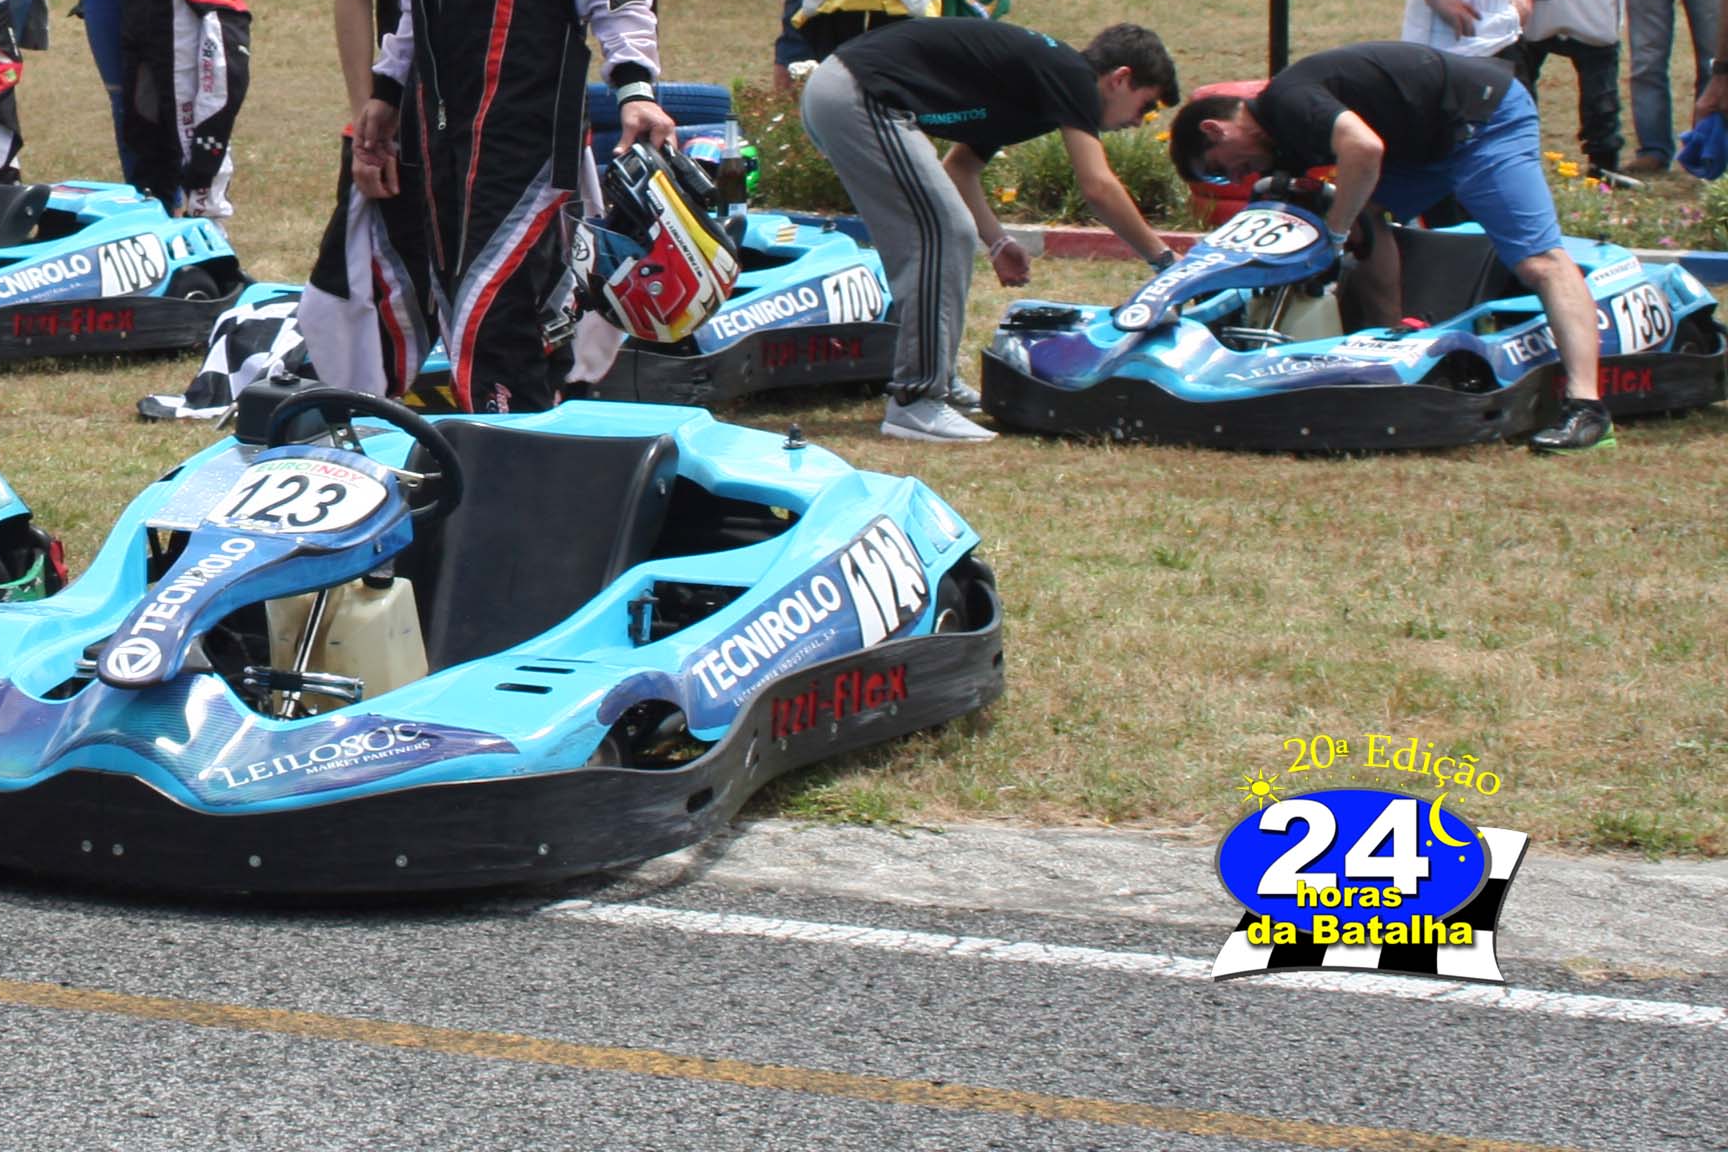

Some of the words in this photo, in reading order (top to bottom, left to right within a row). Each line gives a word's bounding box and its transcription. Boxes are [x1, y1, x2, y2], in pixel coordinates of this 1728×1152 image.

[1217, 214, 1295, 247] 136
[103, 237, 160, 294] 108
[708, 286, 820, 340] TECNIROLO
[832, 270, 882, 323] 100
[1621, 288, 1666, 350] 136
[256, 461, 365, 482] EUROINDY
[224, 474, 347, 527] 123
[130, 537, 256, 636] TECNIROLO
[847, 526, 930, 639] 123
[692, 574, 842, 699] TECNIROLO
[214, 723, 422, 789] LEILOSOC
[306, 757, 359, 775] MARKET
[363, 739, 431, 763] PARTNERS
